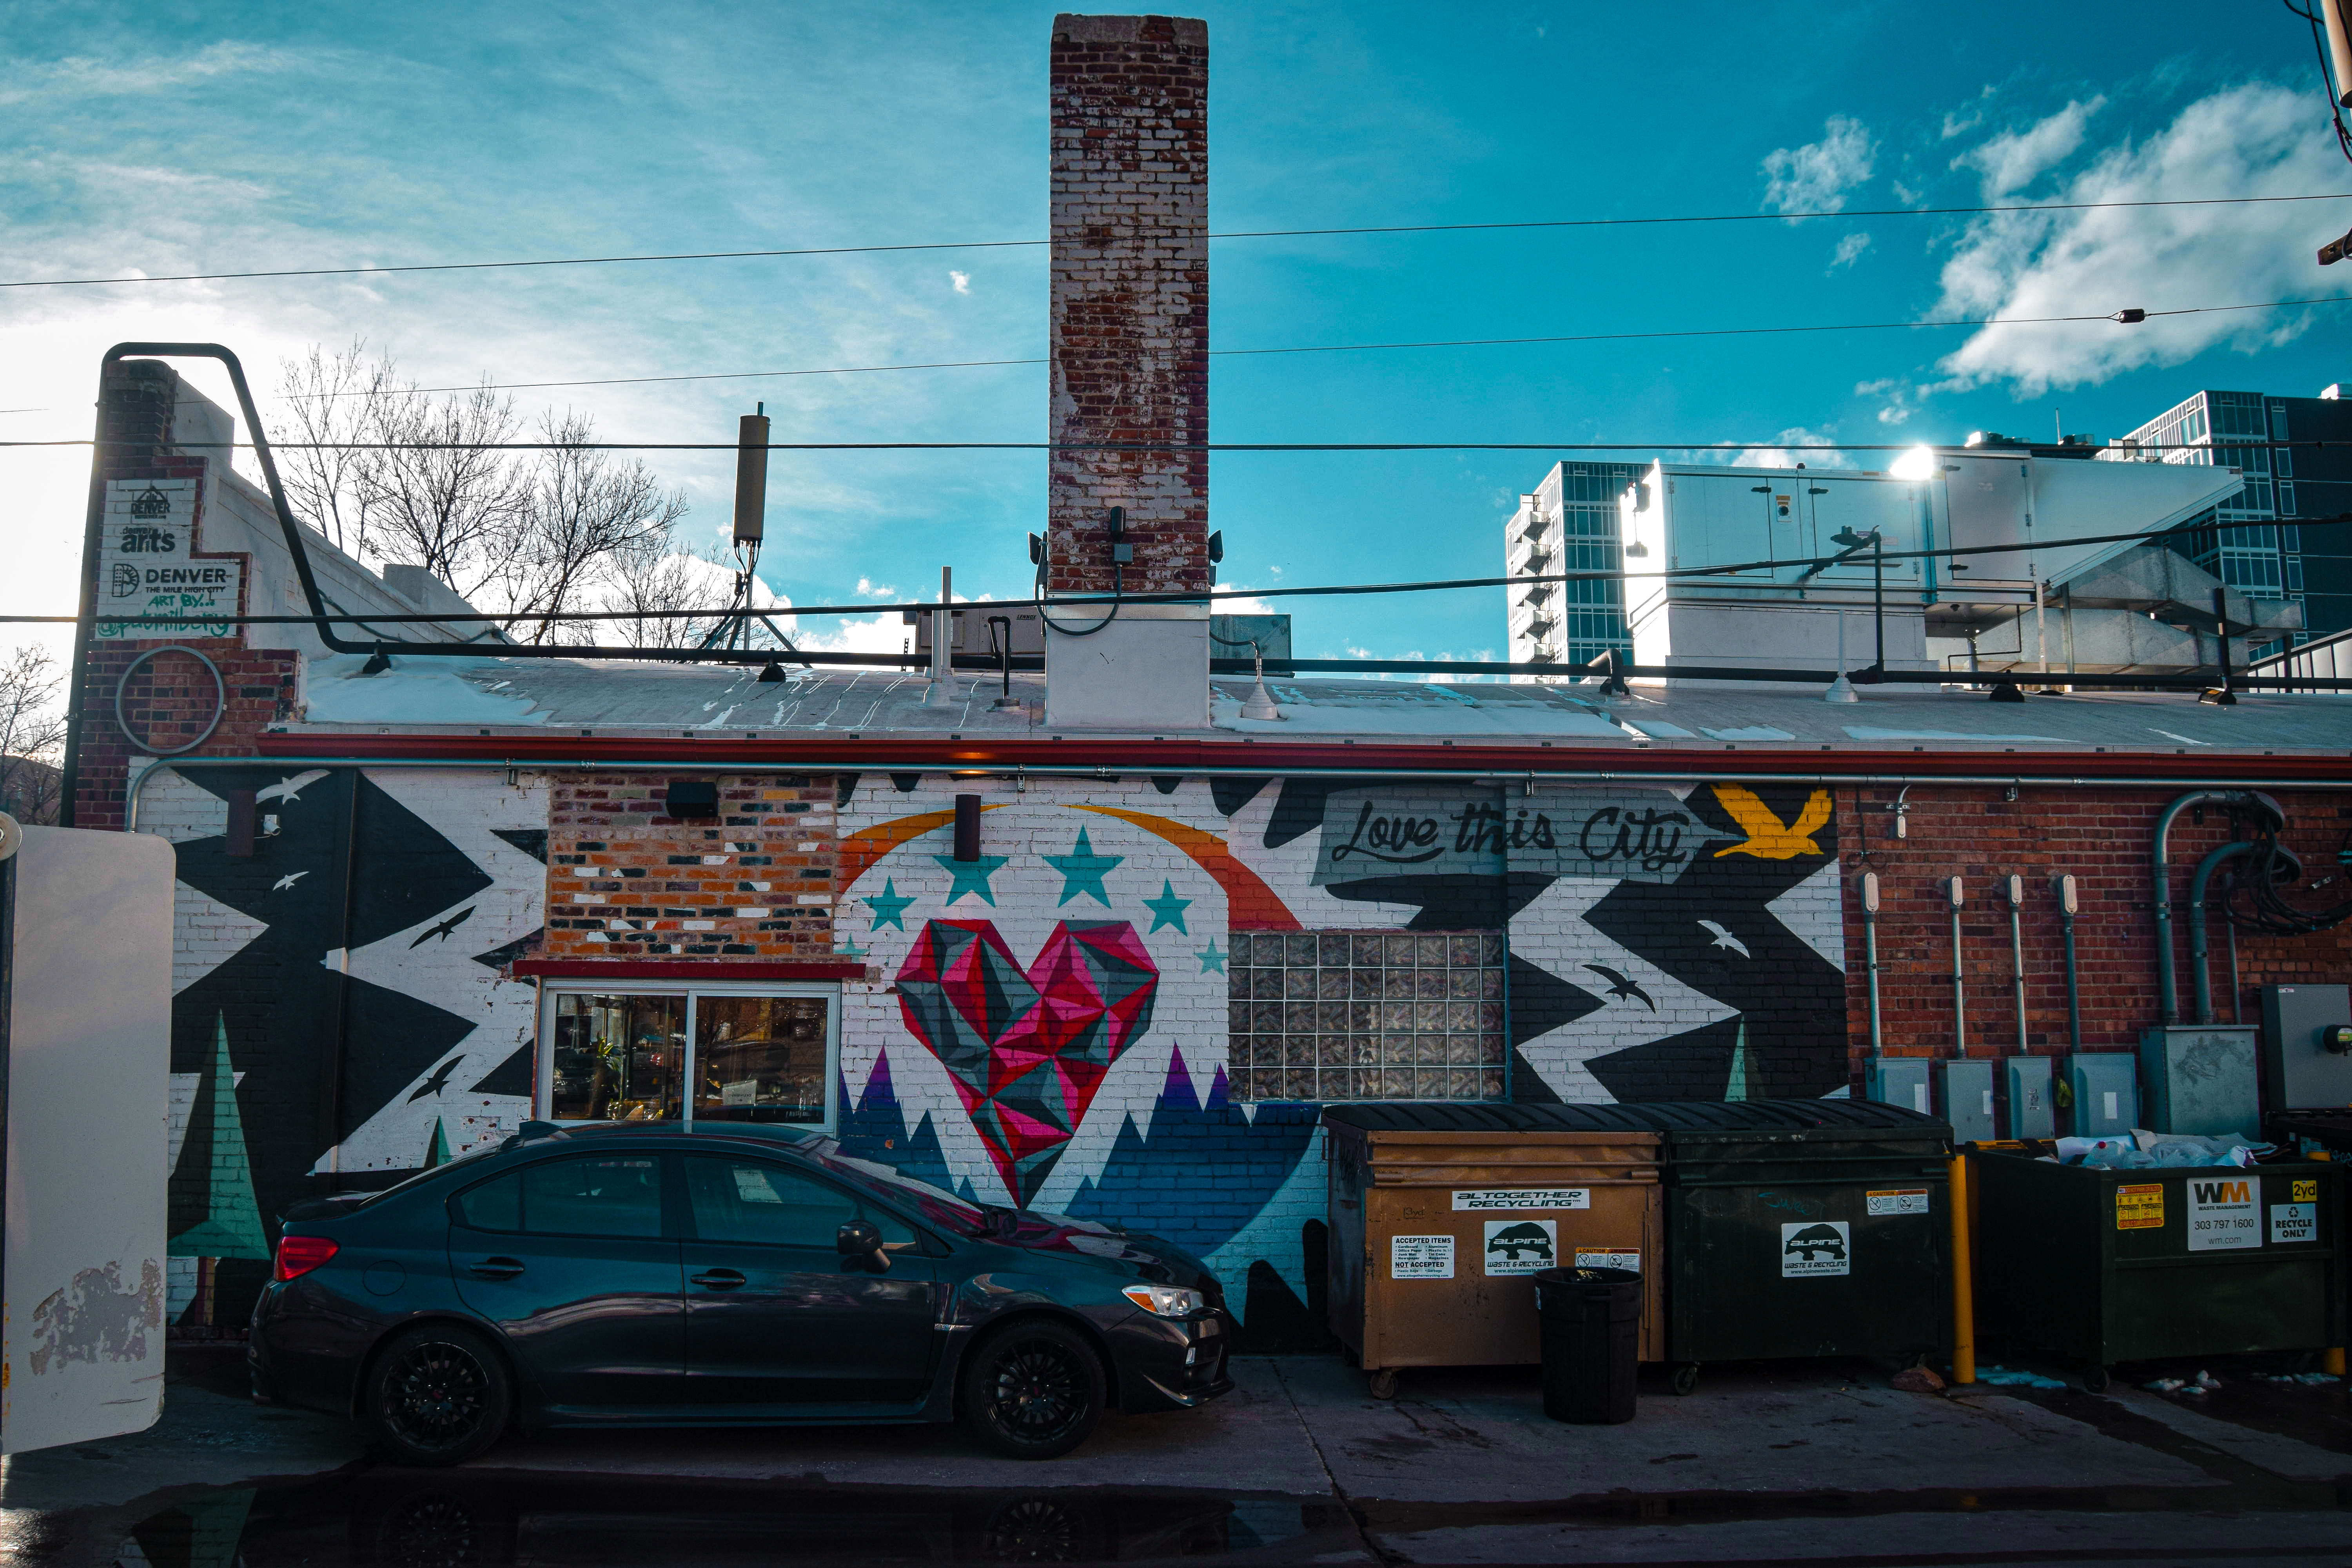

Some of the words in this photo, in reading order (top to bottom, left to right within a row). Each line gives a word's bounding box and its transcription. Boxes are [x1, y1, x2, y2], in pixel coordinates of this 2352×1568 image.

[131, 502, 170, 514] DENVER
[121, 529, 175, 553] arts
[145, 568, 226, 583] DENVER
[148, 595, 175, 608] ART
[181, 593, 215, 608] BY...
[1332, 800, 1446, 863] Love
[1450, 802, 1555, 855] this
[1580, 806, 1690, 871] City
[2194, 1181, 2251, 1204] WM
[2294, 1183, 2316, 1199] 2yd
[2194, 1220, 2210, 1230] 303
[2213, 1220, 2230, 1229] 797
[2233, 1219, 2254, 1228] 1600
[2275, 1219, 2312, 1229] RECYCLE
[2282, 1229, 2306, 1238] ONLY
